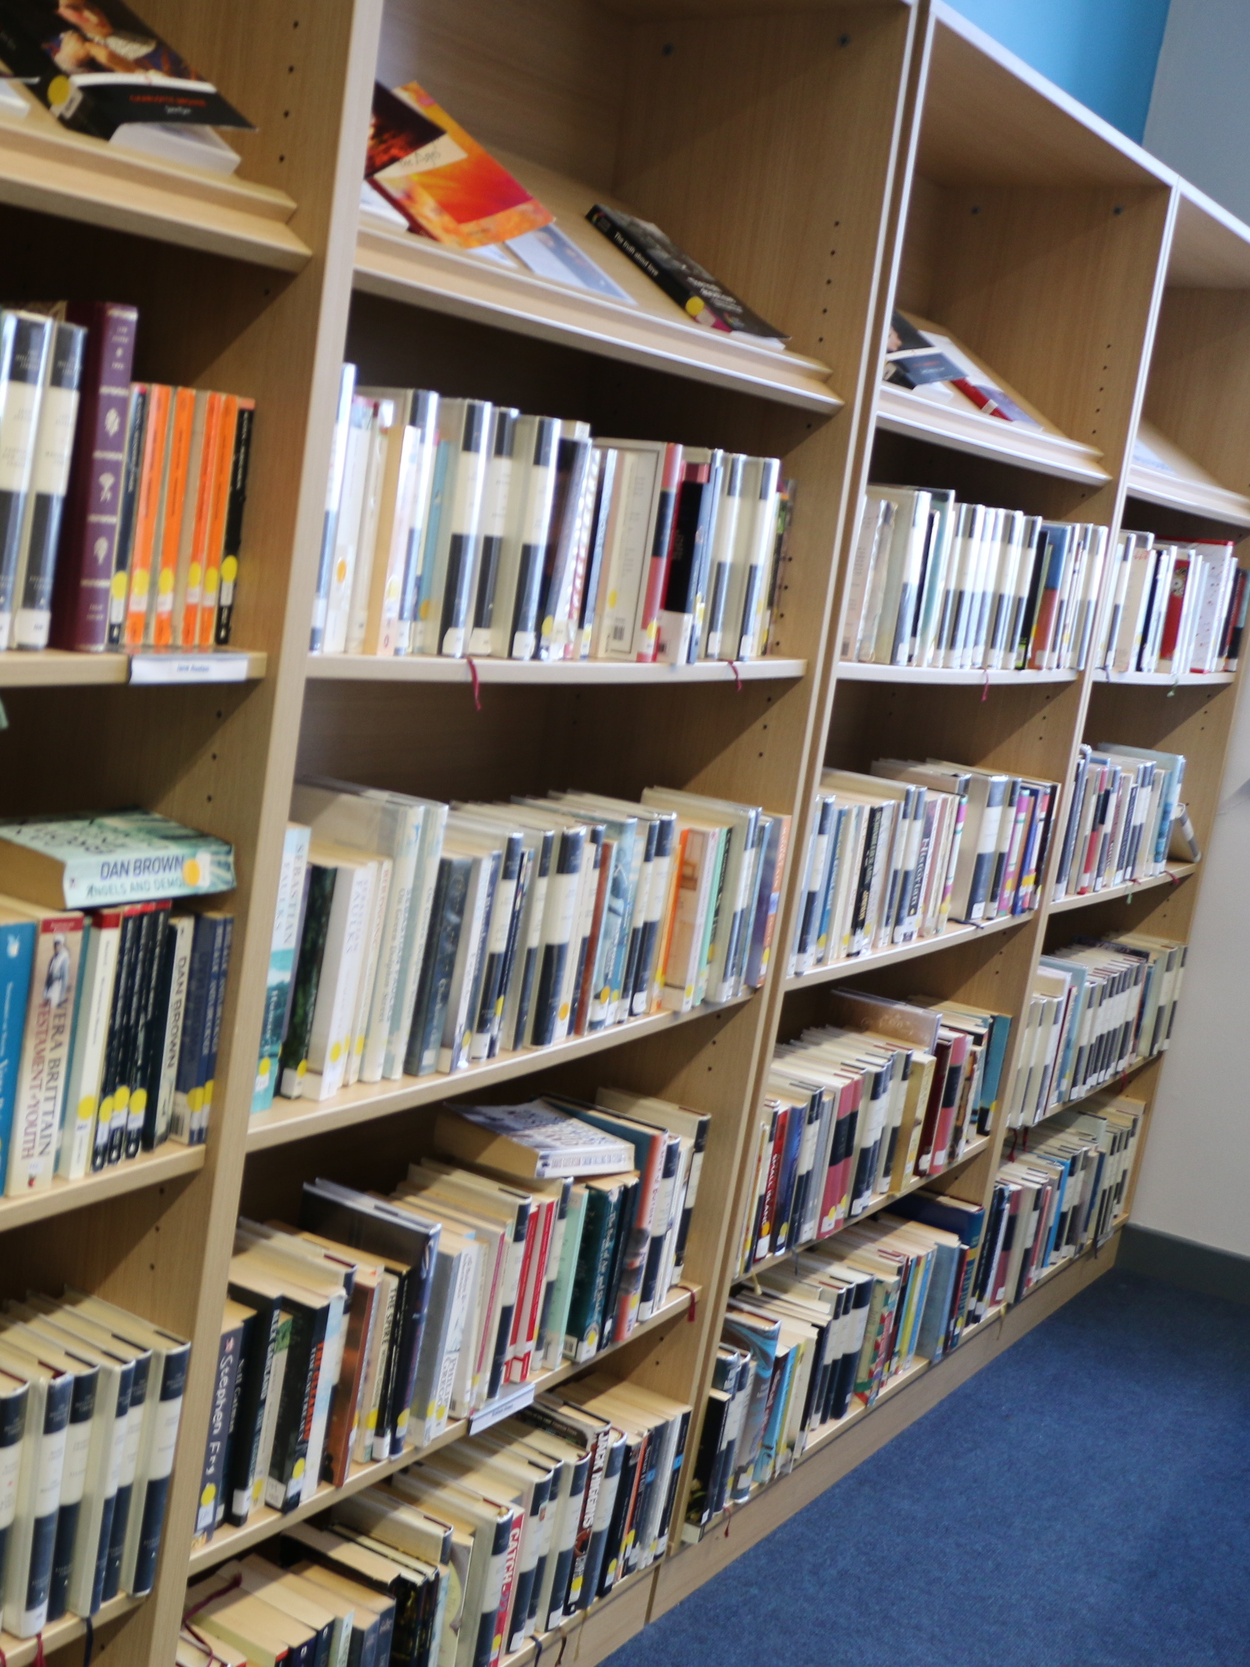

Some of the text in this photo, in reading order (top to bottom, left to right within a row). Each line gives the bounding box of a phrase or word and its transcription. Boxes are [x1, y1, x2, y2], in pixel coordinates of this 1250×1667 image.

[614, 231, 659, 277] The truth about love
[86, 878, 184, 897] ANGELS AND DEMO
[100, 855, 184, 881] DAN BROWN
[274, 862, 292, 931] FAULKS
[282, 842, 306, 945] SEBASTIAN
[911, 837, 931, 906] Historian
[389, 901, 404, 941] Green
[381, 945, 398, 989] Dolphin
[166, 956, 187, 1069] DAN BROWN
[377, 992, 390, 1023] Street
[21, 998, 53, 1160] TESTAMENT YOUTH
[37, 997, 69, 1157] VERA BRITTAIN
[766, 1152, 778, 1190] SMALL
[607, 1212, 617, 1227] The
[385, 1286, 398, 1312] THE
[260, 1309, 280, 1401] ALEX GARLAND
[381, 1314, 395, 1345] SPIRE
[205, 1355, 234, 1477] Stephen Fry
[302, 1341, 325, 1441] THE CLEARING
[581, 1432, 609, 1529] JACK HIGGINS
[637, 1445, 653, 1494] Susan Hill
[496, 1526, 521, 1612] CATCH-22
